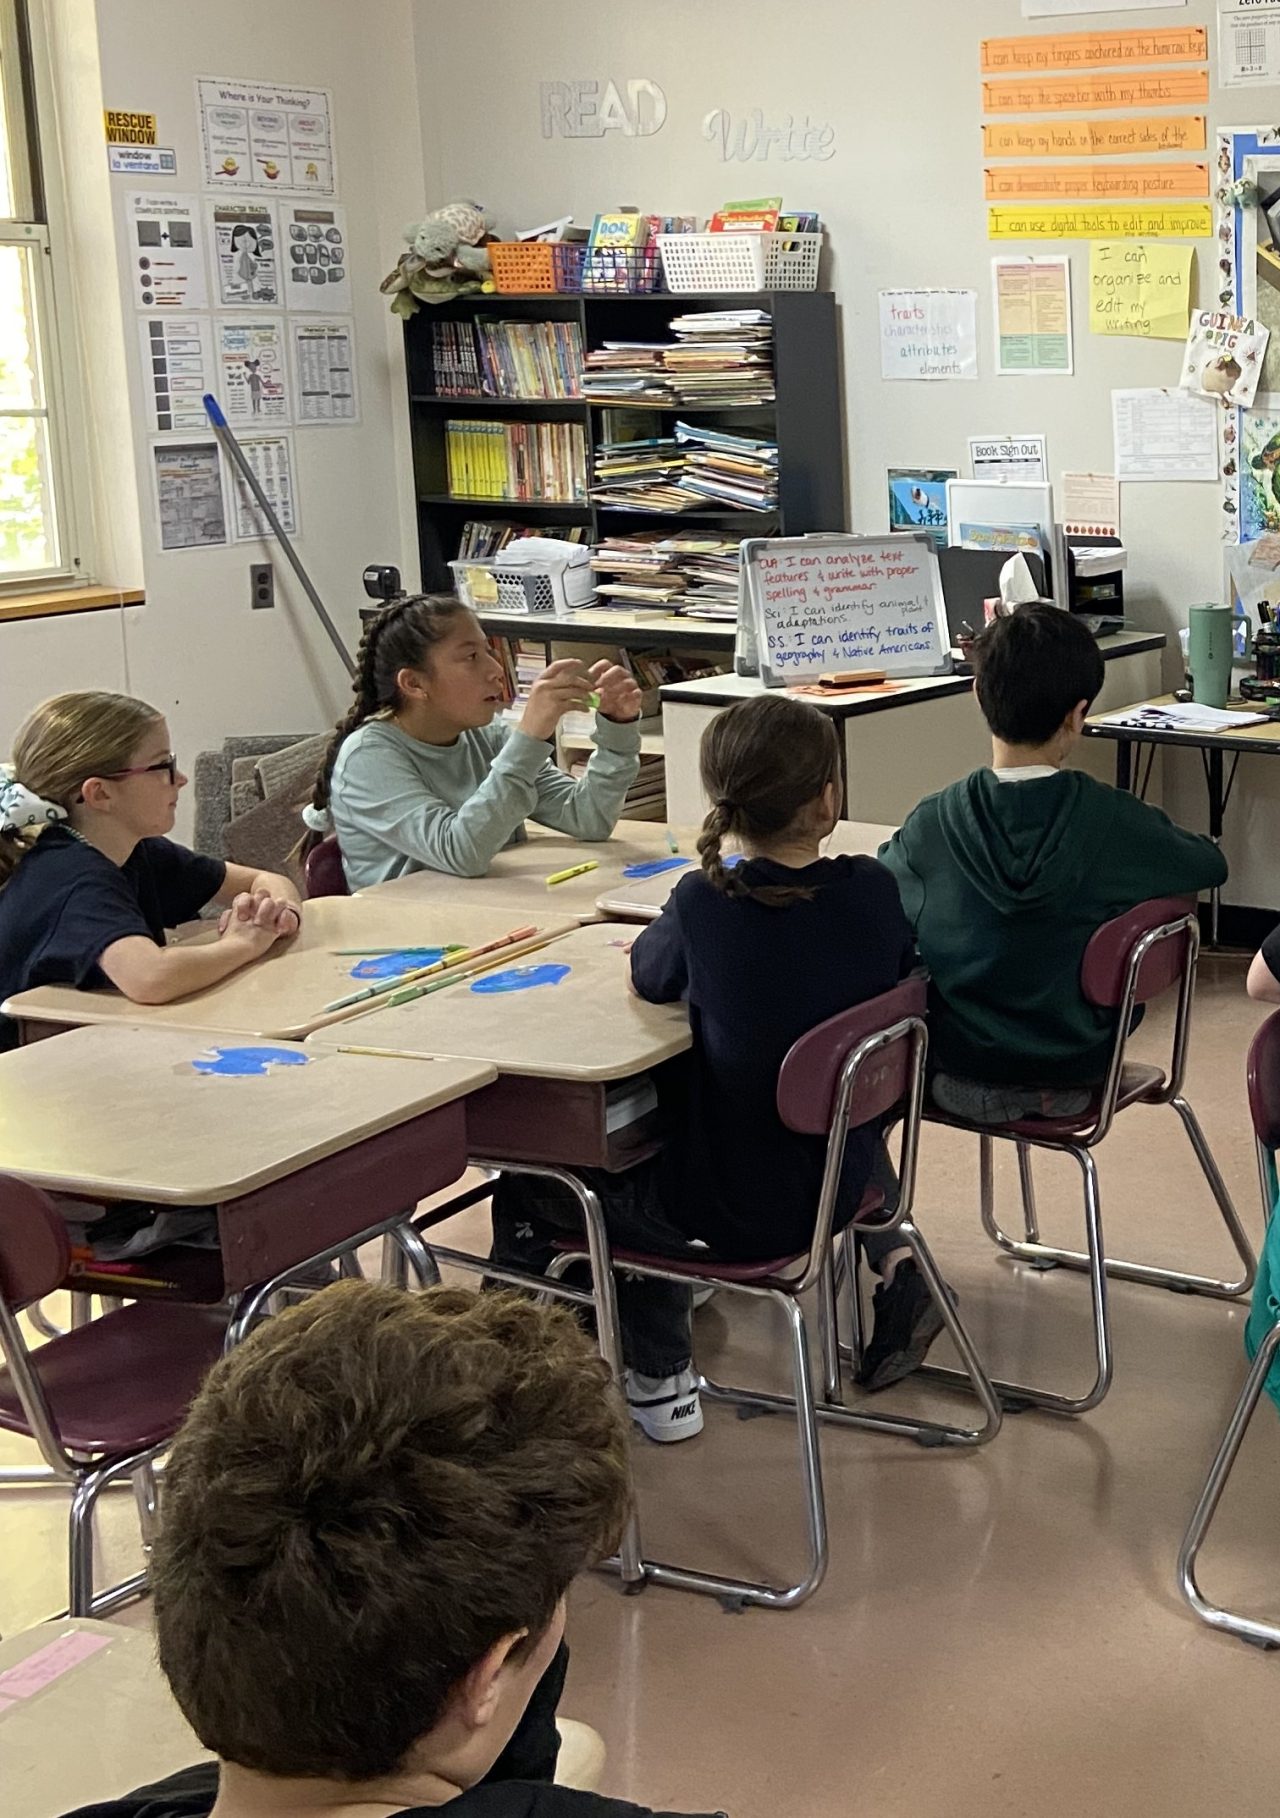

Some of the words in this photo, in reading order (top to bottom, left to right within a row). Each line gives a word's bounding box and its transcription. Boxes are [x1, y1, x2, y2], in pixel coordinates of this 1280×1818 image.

[540, 79, 668, 139] READ
[108, 112, 152, 130] RESCUE
[107, 127, 156, 145] WINDOW
[703, 108, 836, 162] Write
[118, 150, 152, 160] window
[112, 160, 122, 168] la
[124, 161, 160, 170] ventana
[992, 214, 1003, 234] I
[1009, 220, 1027, 232] can
[1030, 220, 1046, 232] use
[1051, 213, 1078, 237] digital
[1081, 216, 1106, 231] tools
[1108, 216, 1120, 230] to
[1123, 215, 1144, 231] edit
[1148, 214, 1164, 231] and
[1170, 219, 1207, 236] improve
[1098, 248, 1112, 261] I
[1124, 252, 1148, 264] can
[1093, 274, 1151, 296] organize
[1158, 272, 1182, 286] and
[891, 304, 924, 320] traits
[1096, 298, 1124, 314] edit
[1131, 302, 1146, 318] my
[1200, 312, 1254, 336] GUINEA
[1214, 331, 1238, 348] PIG
[900, 344, 958, 358] attributes
[920, 361, 962, 376] elements
[976, 446, 999, 457] Book
[1000, 444, 1020, 458] Sign
[1021, 444, 1038, 456] Out
[786, 556, 796, 567] I
[800, 556, 822, 566] can
[826, 552, 876, 567] analyze
[880, 551, 905, 562] text
[764, 570, 809, 584] features
[828, 569, 856, 581] write
[860, 566, 884, 578] with
[886, 566, 920, 582] proper
[766, 585, 807, 603] spelling
[791, 606, 799, 616] I
[804, 604, 826, 616] can
[832, 600, 874, 615] identify
[879, 596, 920, 608] animal
[795, 632, 806, 646] I
[811, 634, 834, 646] can
[838, 626, 882, 644] identify
[886, 624, 918, 637] traits
[921, 622, 935, 636] of
[776, 648, 826, 668] geography
[843, 646, 874, 658] Native
[670, 1399, 697, 1420] NIKE
